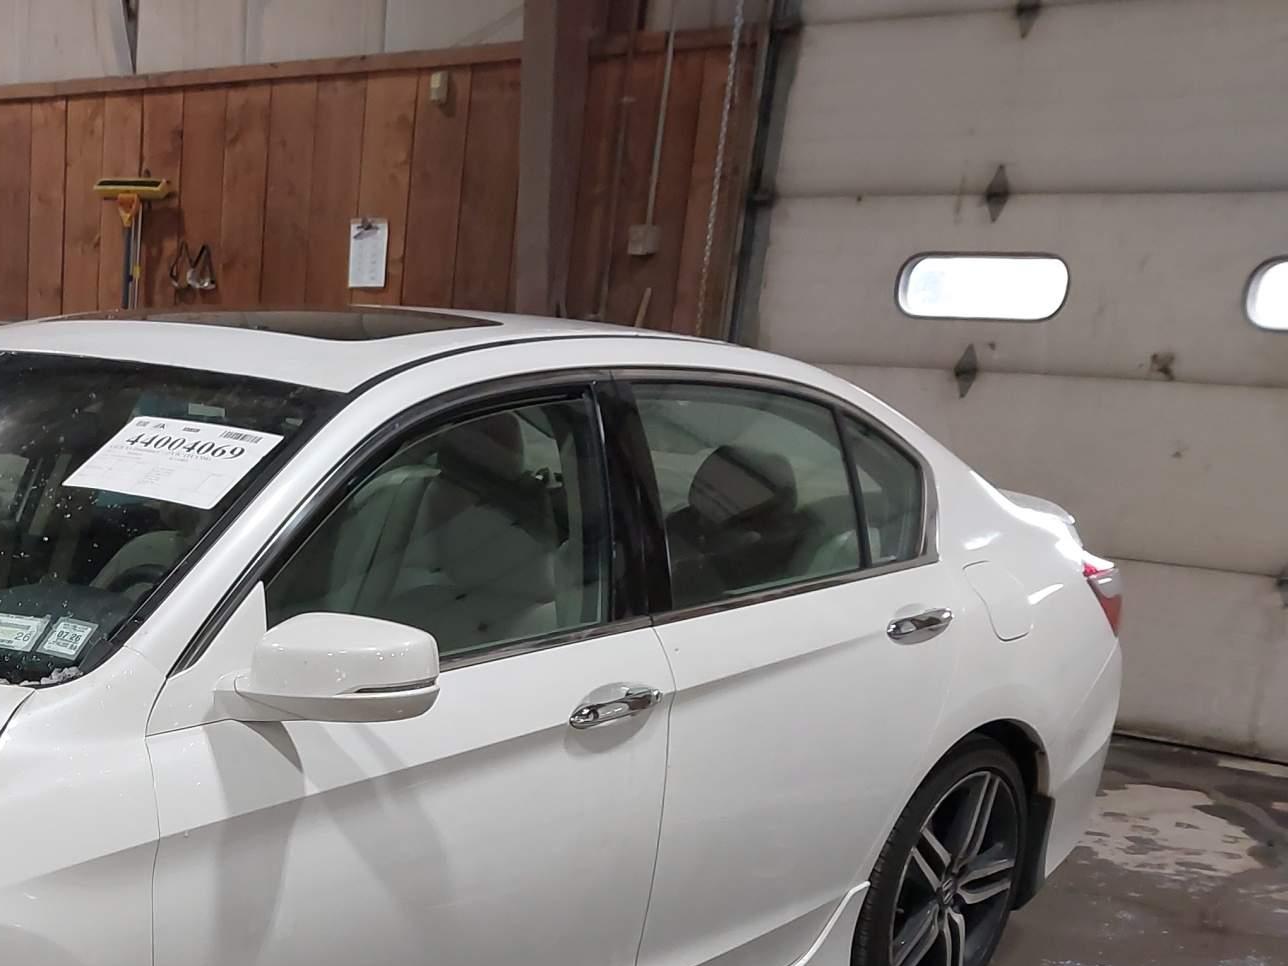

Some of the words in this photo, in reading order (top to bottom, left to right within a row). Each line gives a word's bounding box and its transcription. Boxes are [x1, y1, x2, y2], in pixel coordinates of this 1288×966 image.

[126, 433, 246, 460] 44004069
[14, 632, 32, 642] 26
[69, 634, 83, 642] 26
